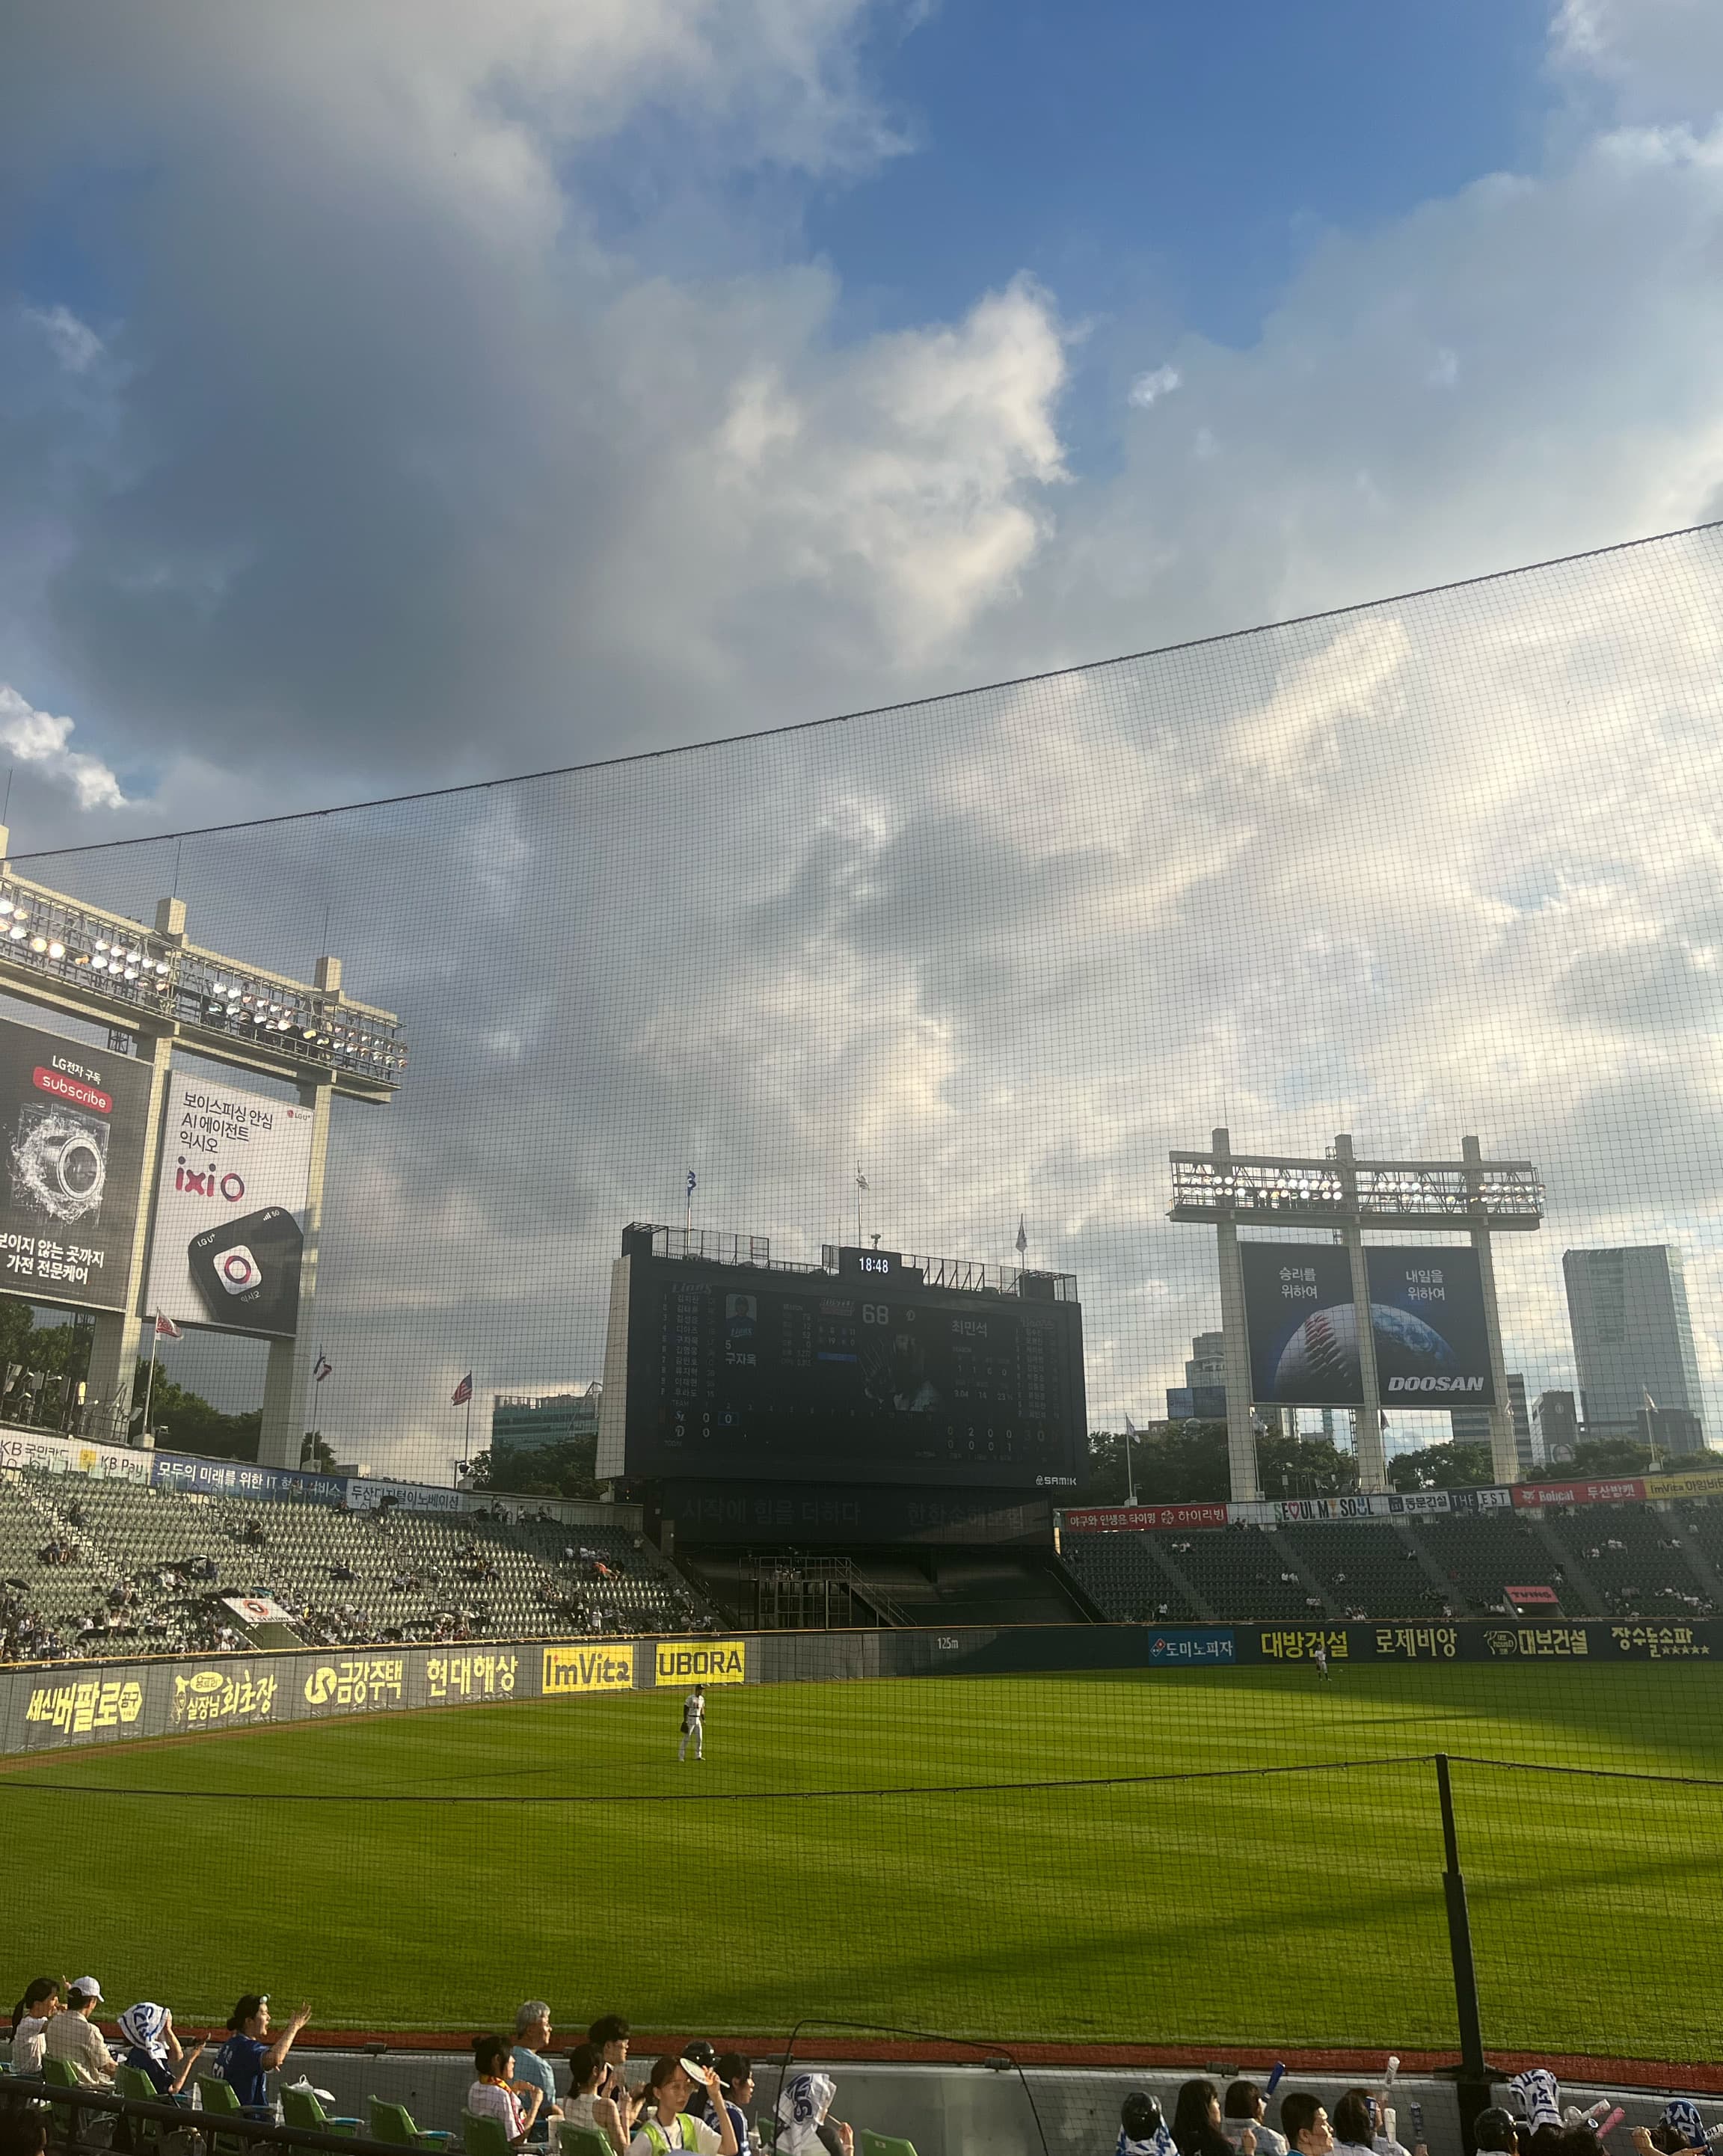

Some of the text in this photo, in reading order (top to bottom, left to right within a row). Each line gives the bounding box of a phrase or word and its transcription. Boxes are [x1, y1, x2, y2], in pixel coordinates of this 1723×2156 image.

[52, 1055, 102, 1084] LG전자 구독
[43, 1076, 106, 1108] subscribe
[183, 1093, 273, 1130] 보이스피싱 안심
[182, 1113, 250, 1141] AI 에이전트
[180, 1131, 218, 1153] 익시오
[197, 1238, 207, 1247] LG
[37, 1239, 64, 1260] 않는
[66, 1245, 105, 1268] 곳까지
[7, 1254, 89, 1285] 가전 전문케어
[859, 1256, 888, 1274] 18:48
[1279, 1267, 1317, 1283] 승리를
[1406, 1269, 1444, 1284] 내일을
[240, 1290, 262, 1303] 익시오
[1280, 1285, 1318, 1299] 위하여
[1407, 1286, 1445, 1301] 위하여
[862, 1303, 888, 1325] 68
[951, 1320, 987, 1337] 최민석
[725, 1339, 731, 1350] 5
[725, 1352, 757, 1366] 구자욱
[1388, 1377, 1484, 1392] DOOSAN
[702, 1413, 710, 1423] 0
[725, 1414, 732, 1424] 0
[702, 1428, 710, 1438] 0
[968, 1427, 974, 1437] 2
[987, 1428, 994, 1438] 0
[1006, 1429, 1013, 1439] 0
[1, 1440, 22, 1456] KB
[968, 1440, 975, 1450] 0
[988, 1442, 995, 1452] 0
[102, 1455, 117, 1470] KB
[121, 1459, 143, 1478] Pay
[157, 1461, 196, 1481] 모두의
[200, 1466, 236, 1487] 미래를
[239, 1471, 263, 1490] 위한
[266, 1475, 277, 1489] IT
[1044, 1476, 1077, 1486] SAMIK
[1452, 1493, 1505, 1507] THE EST
[1539, 1484, 1636, 1502] Bobcat 두산밥캣
[683, 1498, 861, 1526] 시작에 힘을 더하다
[1339, 1497, 1374, 1517] SOUL
[1405, 1496, 1447, 1510] 동문건설
[906, 1502, 1024, 1530] 한화손해보험
[1070, 1514, 1155, 1526] 야구와 인생은 타이밍
[1178, 1509, 1224, 1522] 하이리빙
[938, 1637, 959, 1649] 125m
[1166, 1641, 1233, 1657] 도미노피자
[1262, 1631, 1349, 1658] 대방건설
[1376, 1628, 1458, 1657] 로제비앙
[1518, 1630, 1588, 1654] 대보건설
[1612, 1627, 1694, 1658] 장수돌소파
[659, 1651, 742, 1676] UBORA
[337, 1659, 403, 1704] 금강주택
[427, 1655, 518, 1698] 현대해상
[187, 1669, 278, 1720] 실장님 회초장
[25, 1681, 121, 1734] 세신버팔로
